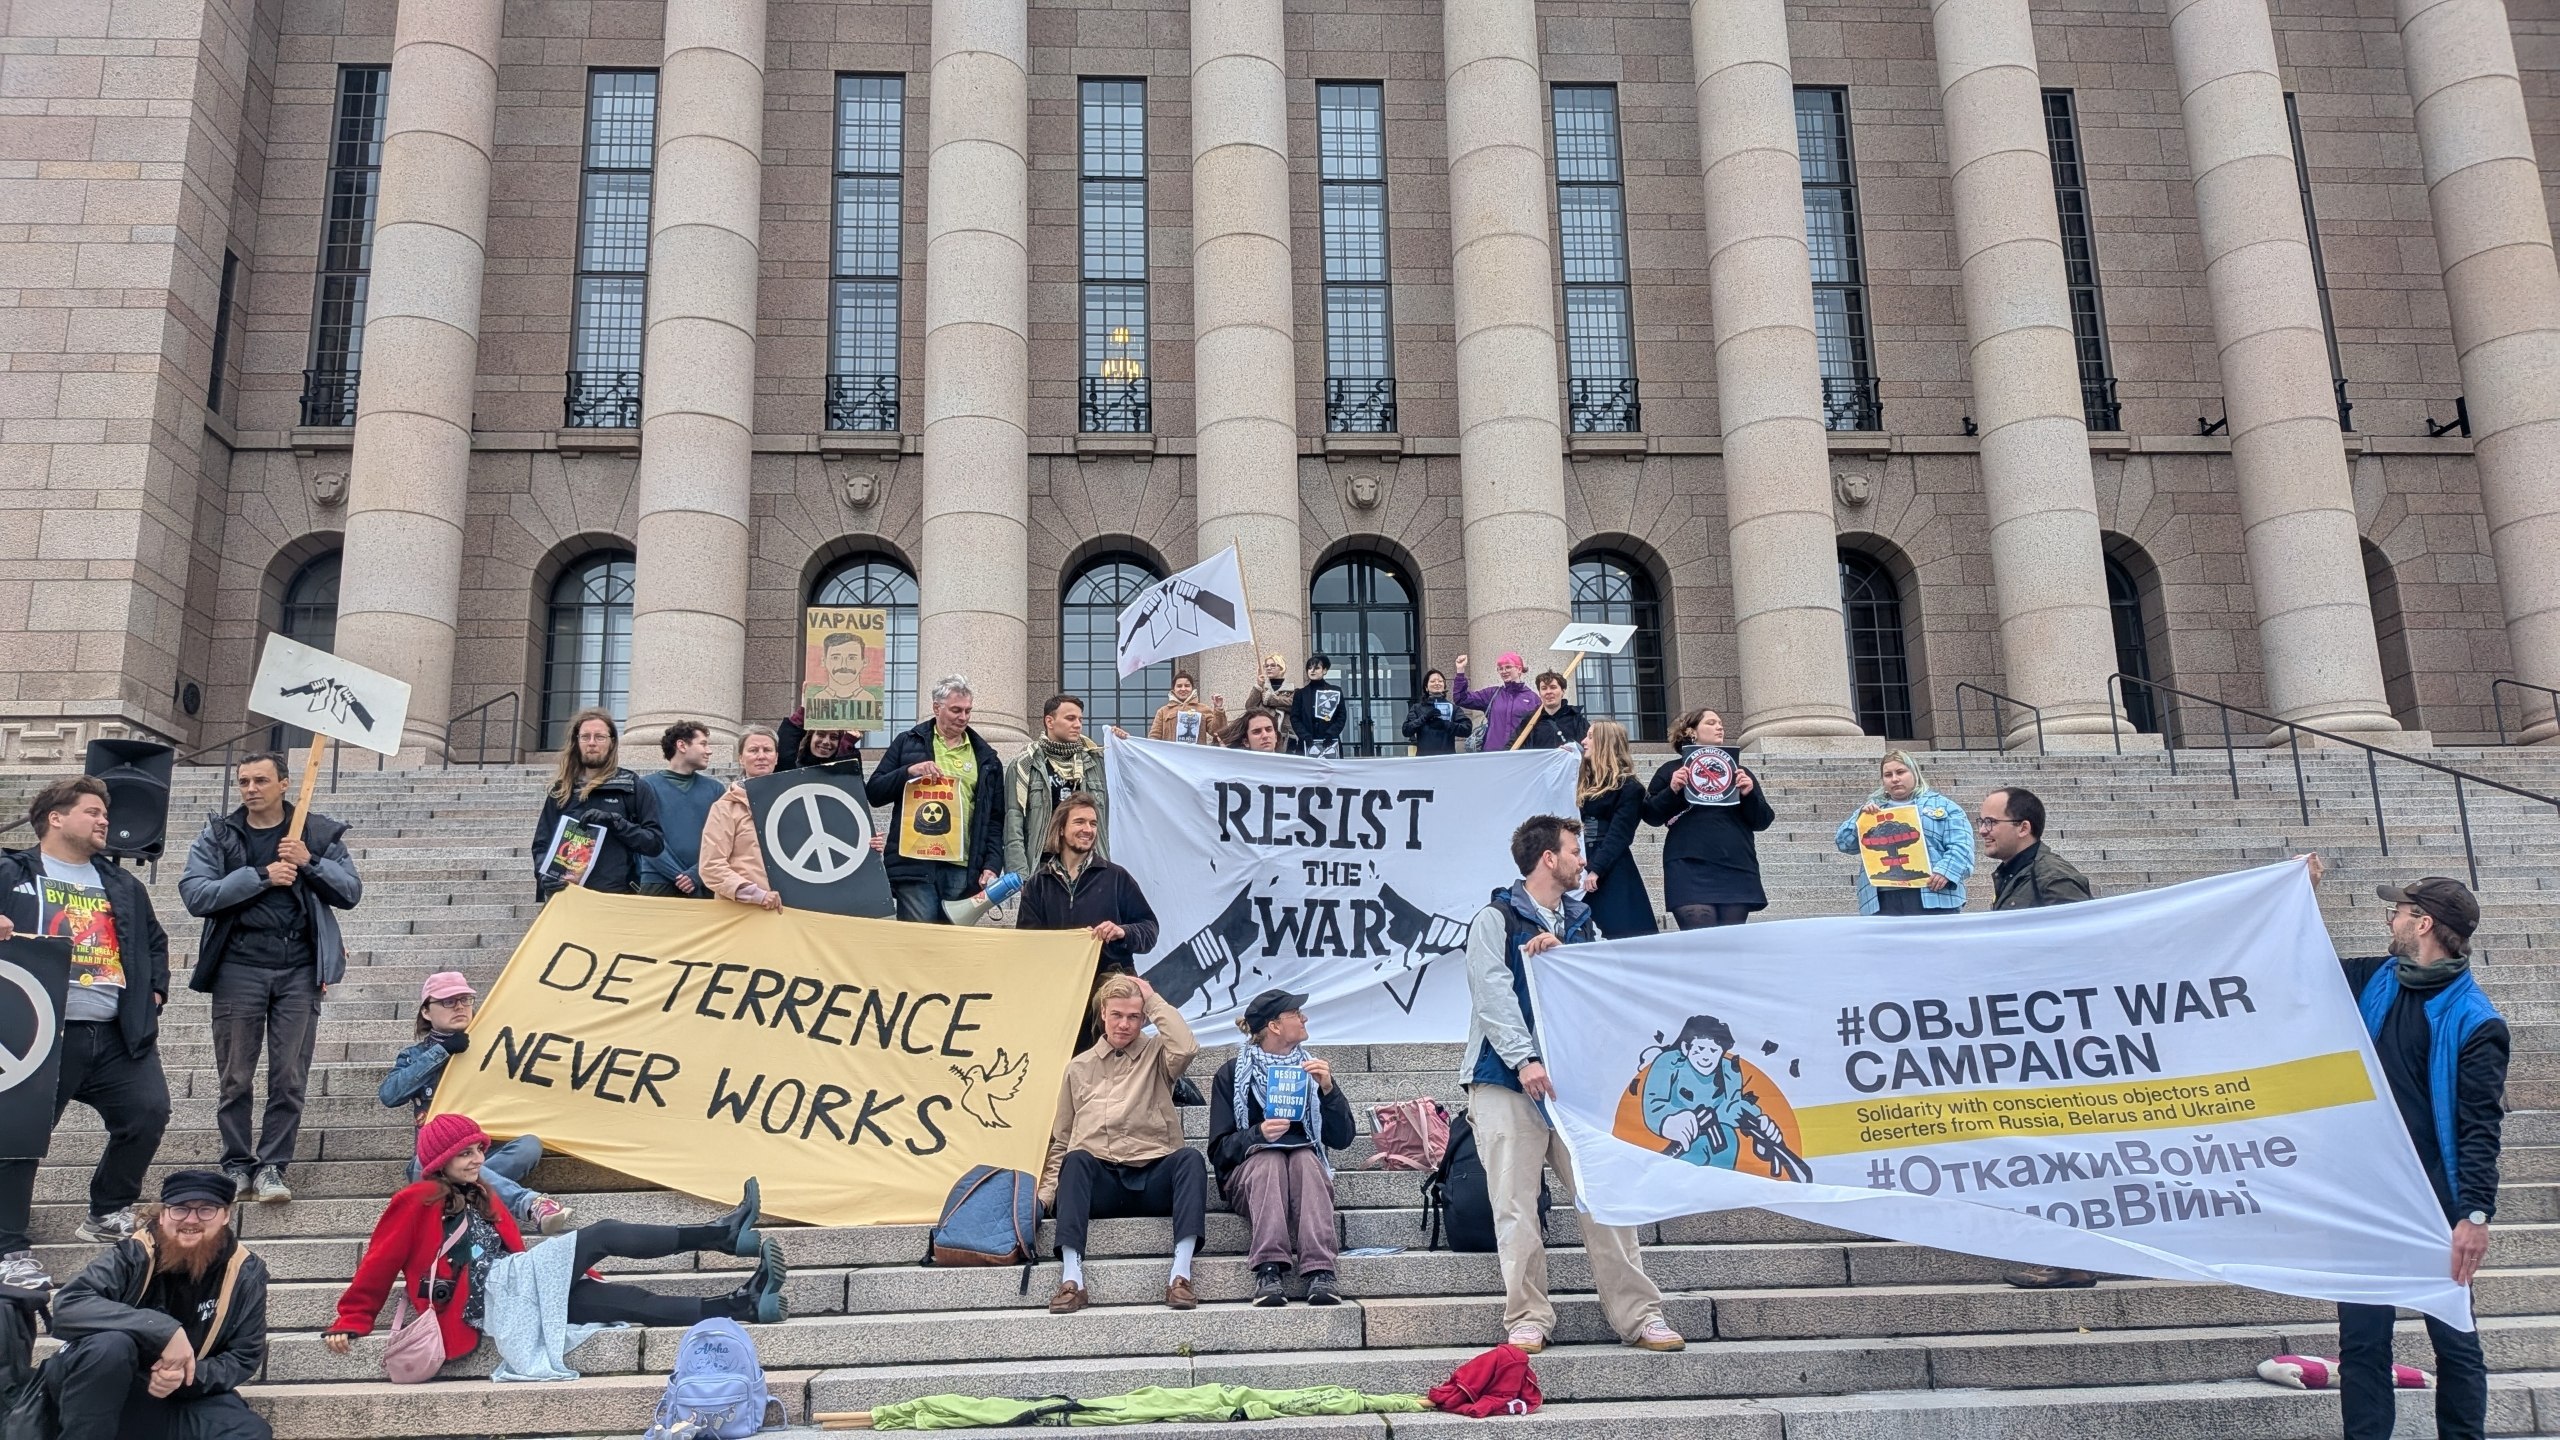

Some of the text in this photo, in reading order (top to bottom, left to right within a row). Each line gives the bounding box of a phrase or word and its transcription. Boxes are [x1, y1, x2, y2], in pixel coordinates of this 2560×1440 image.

[808, 612, 885, 630] VAPAUS
[1690, 748, 1731, 762] ANTI-NUCLEAR
[1697, 793, 1724, 801] ACTION
[1213, 781, 1435, 850] RESIST
[1302, 860, 1362, 887] THE
[46, 888, 66, 905] BY
[1253, 896, 1392, 958] WAR
[76, 944, 90, 953] THE
[77, 954, 94, 964] WAR
[538, 941, 994, 1058] DETERRENCE
[1836, 975, 2257, 1047] #OBJECT WAR
[1845, 1032, 2162, 1094] CAMPAIGN
[1274, 1069, 1301, 1080] RESIST
[479, 1025, 954, 1157] NEVER WORKS
[1278, 1082, 1296, 1092] WAR
[1268, 1094, 1304, 1106] VASTUSTA
[1856, 1075, 2251, 1124] Solidarity with conscientious objectors and
[1273, 1107, 1296, 1118] SOTAA
[1860, 1097, 2256, 1143] deserters from Russia, Belarus and Ukraine
[1866, 1133, 2298, 1197] #ОткажиВойне
[694, 1343, 729, 1354] Aloha
